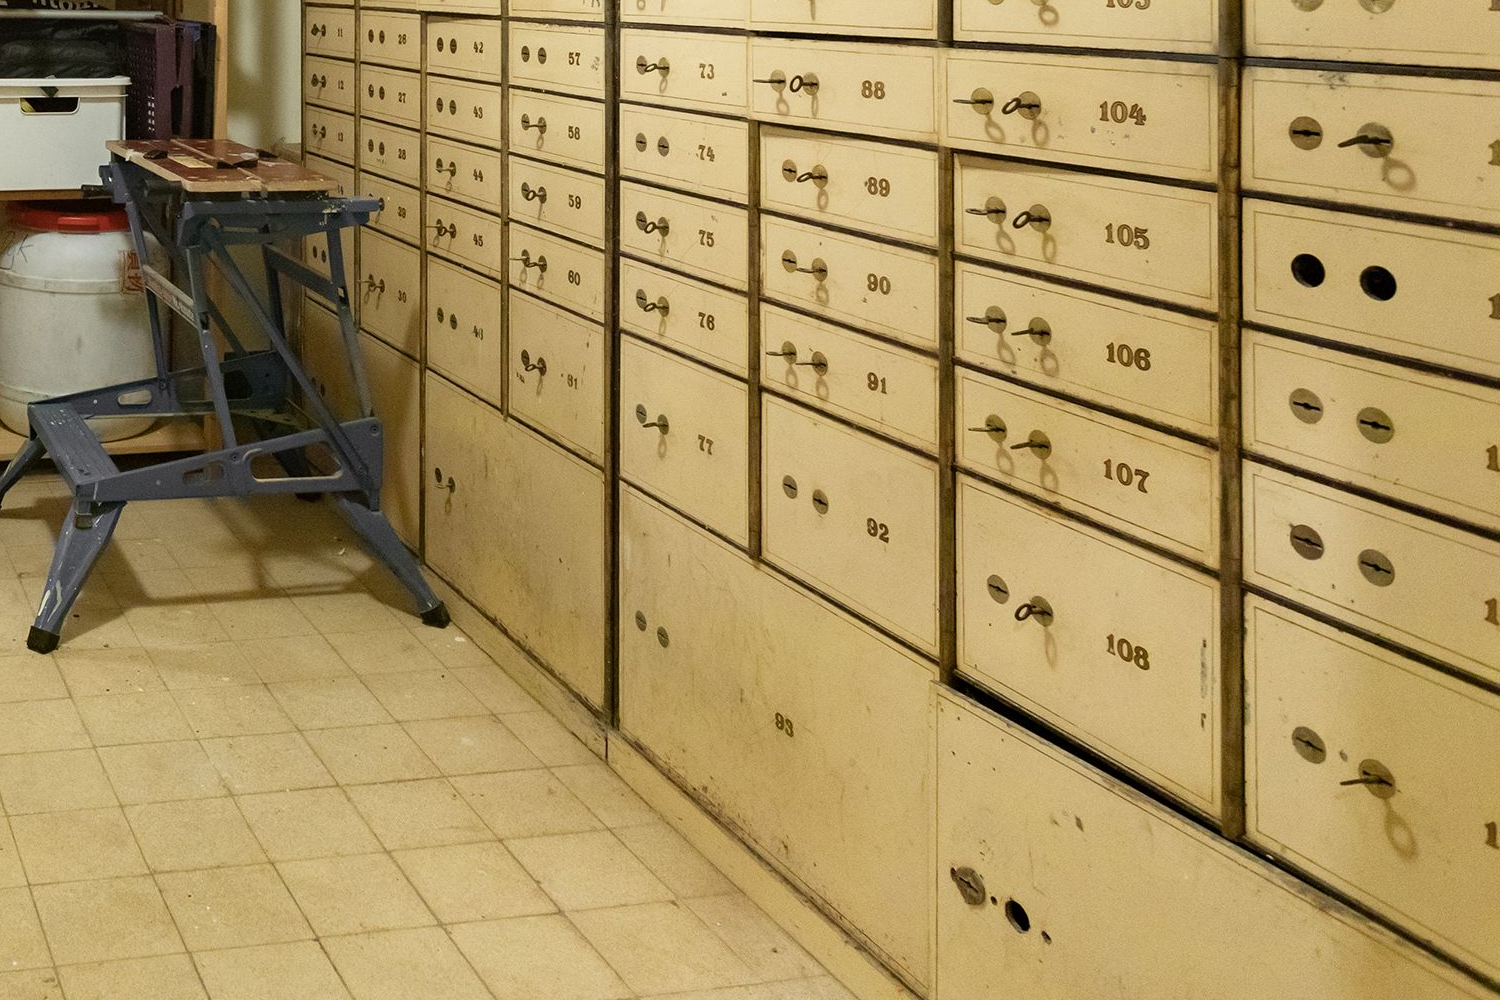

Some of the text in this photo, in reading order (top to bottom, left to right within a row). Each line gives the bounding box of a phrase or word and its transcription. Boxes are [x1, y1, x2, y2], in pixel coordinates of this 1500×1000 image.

[473, 40, 484, 54] 42
[568, 51, 580, 65] 57
[698, 62, 714, 79] 73
[860, 79, 885, 99] 88
[473, 106, 483, 119] 43
[1098, 100, 1146, 125] 104
[567, 125, 580, 140] 58
[698, 144, 715, 162] 74
[472, 168, 484, 182] 44
[866, 176, 890, 197] 89
[568, 194, 581, 209] 59
[472, 233, 484, 246] 45
[698, 229, 715, 247] 75
[1104, 222, 1150, 249] 105
[567, 269, 581, 286] 60
[866, 272, 891, 295] 90
[698, 311, 715, 331] 76
[1105, 341, 1151, 371] 106
[566, 373, 578, 390] 61
[866, 371, 887, 394] 91
[697, 434, 714, 455] 77
[1102, 458, 1150, 493] 107
[866, 517, 889, 543] 92
[1105, 633, 1150, 670] 108
[774, 711, 794, 737] 93
